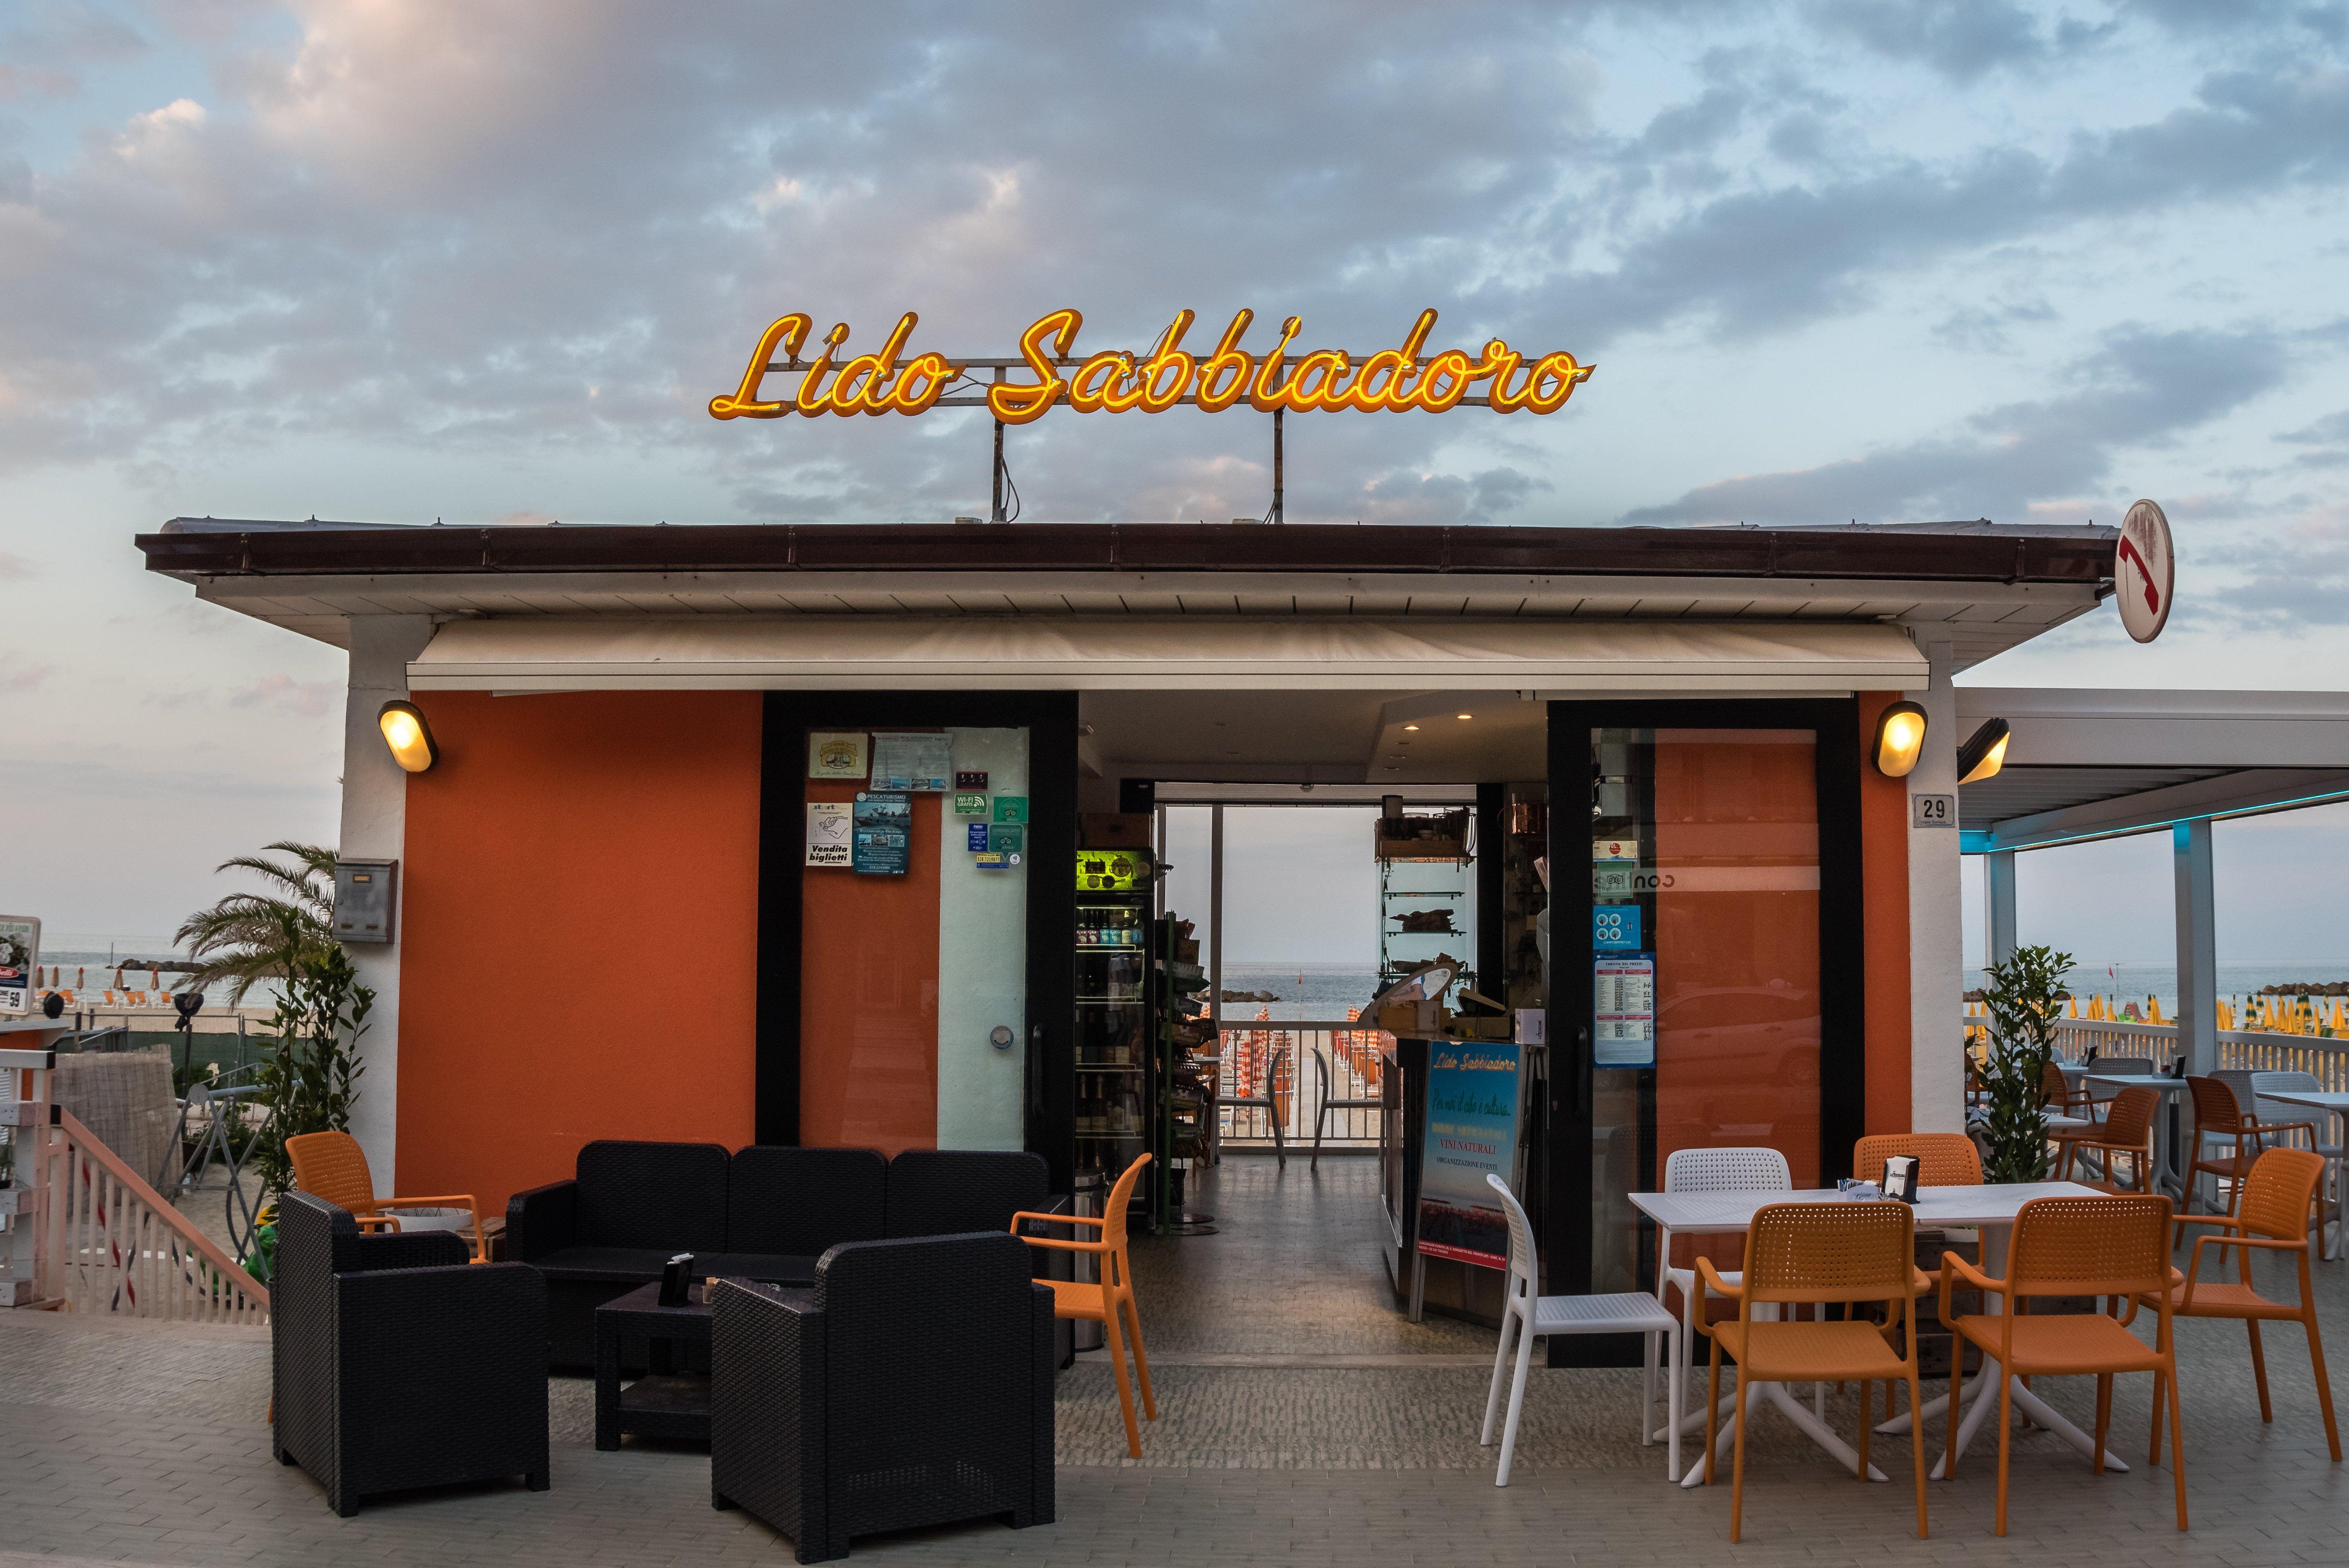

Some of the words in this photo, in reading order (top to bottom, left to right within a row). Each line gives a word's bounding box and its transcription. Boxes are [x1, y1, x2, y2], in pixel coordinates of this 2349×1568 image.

[708, 312, 967, 421] Lido
[987, 308, 1597, 425] Sabbiadoro
[1924, 799, 1945, 818] 29
[809, 853, 848, 862] biglietti
[1433, 1053, 1457, 1069] Lido
[1460, 1053, 1516, 1071] Sabbiadoro
[1432, 1087, 1443, 1110] Per
[1445, 1096, 1456, 1111] noi
[1458, 1090, 1465, 1111] il
[1464, 1092, 1477, 1113] cibo
[1440, 1138, 1456, 1150] VINI
[1458, 1141, 1496, 1155] NATURALI
[1436, 1156, 1479, 1168] ORGANIZZAZIONE
[1480, 1162, 1497, 1171] EVENTI
